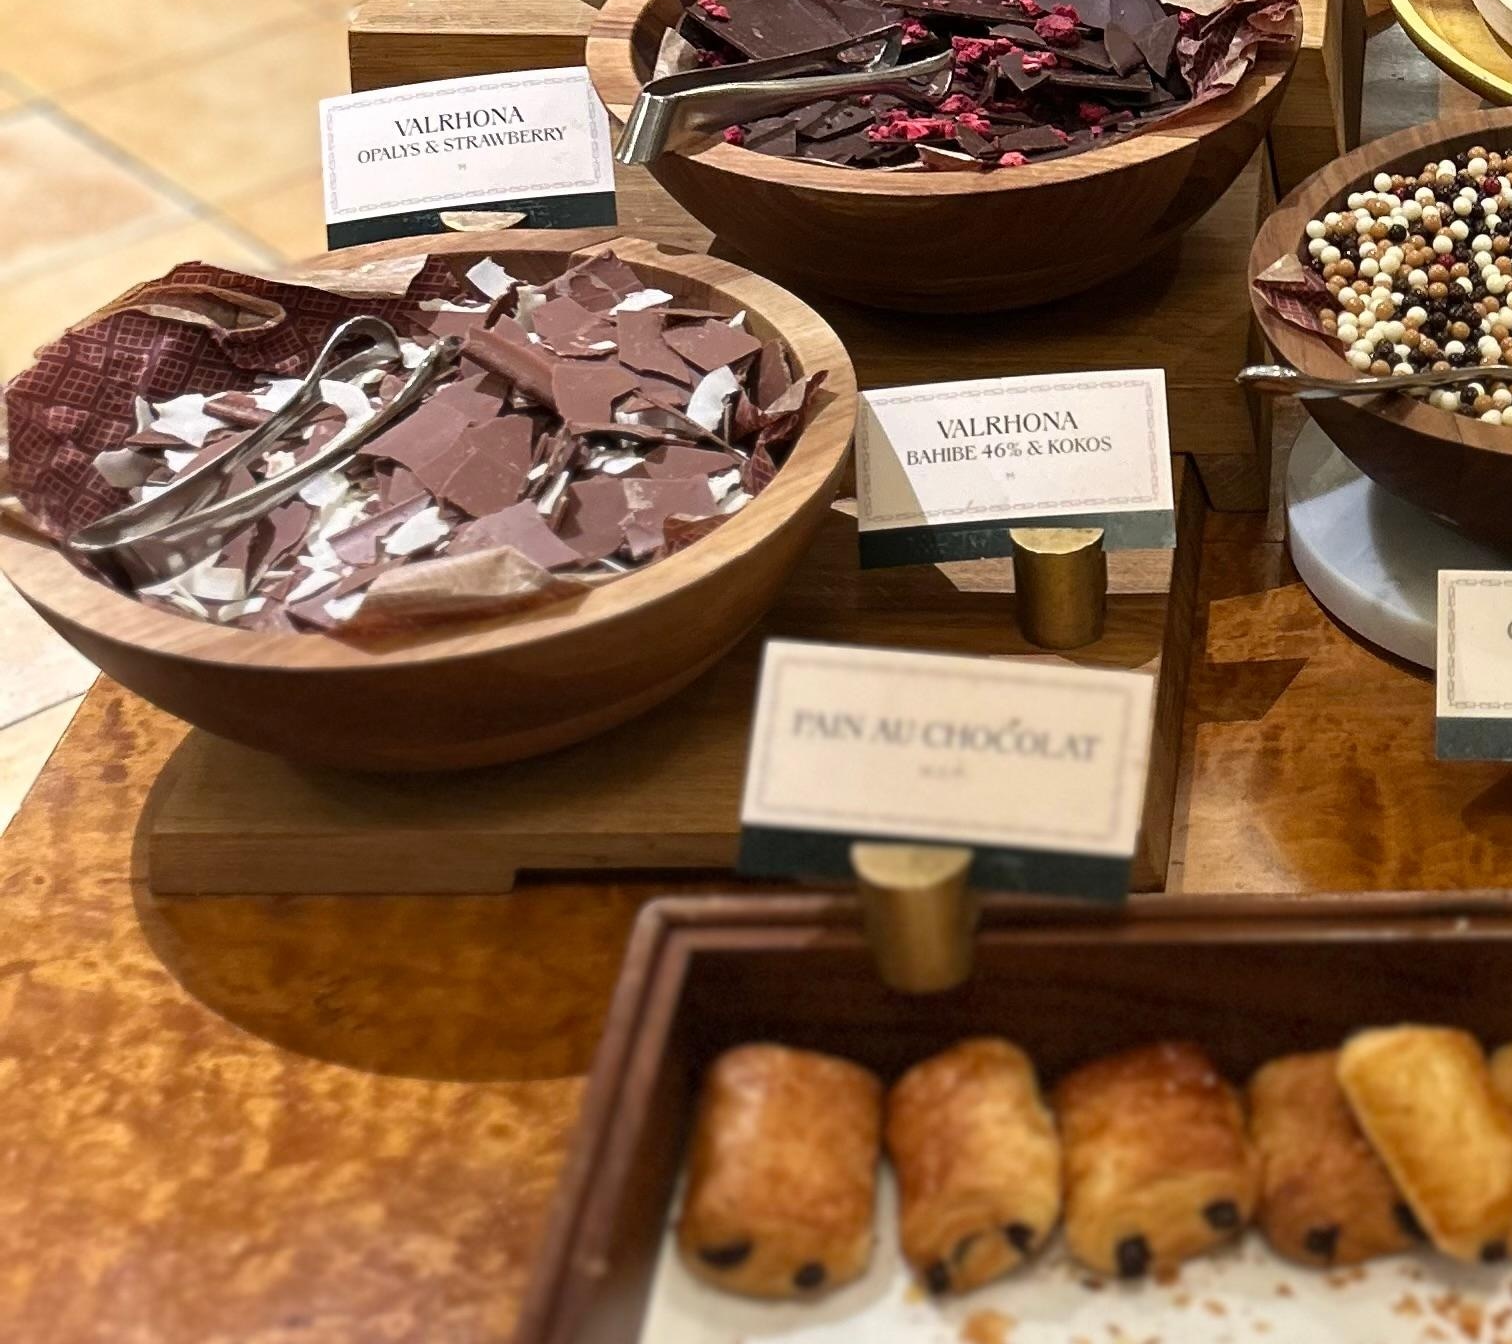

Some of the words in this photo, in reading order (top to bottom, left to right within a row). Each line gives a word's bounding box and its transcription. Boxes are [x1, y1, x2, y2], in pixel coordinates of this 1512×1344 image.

[394, 106, 525, 137] VALRHONA
[357, 142, 421, 164] OPALYS
[425, 140, 439, 154] &
[443, 126, 567, 152] STRAWBERRY
[937, 411, 1078, 439] VALRHONA
[906, 445, 977, 466] BAHIBE
[981, 441, 1023, 458] 46%
[1027, 440, 1043, 455] &
[1048, 436, 1113, 454] KOKOS
[792, 709, 865, 741] PAIN
[869, 715, 918, 747] AU
